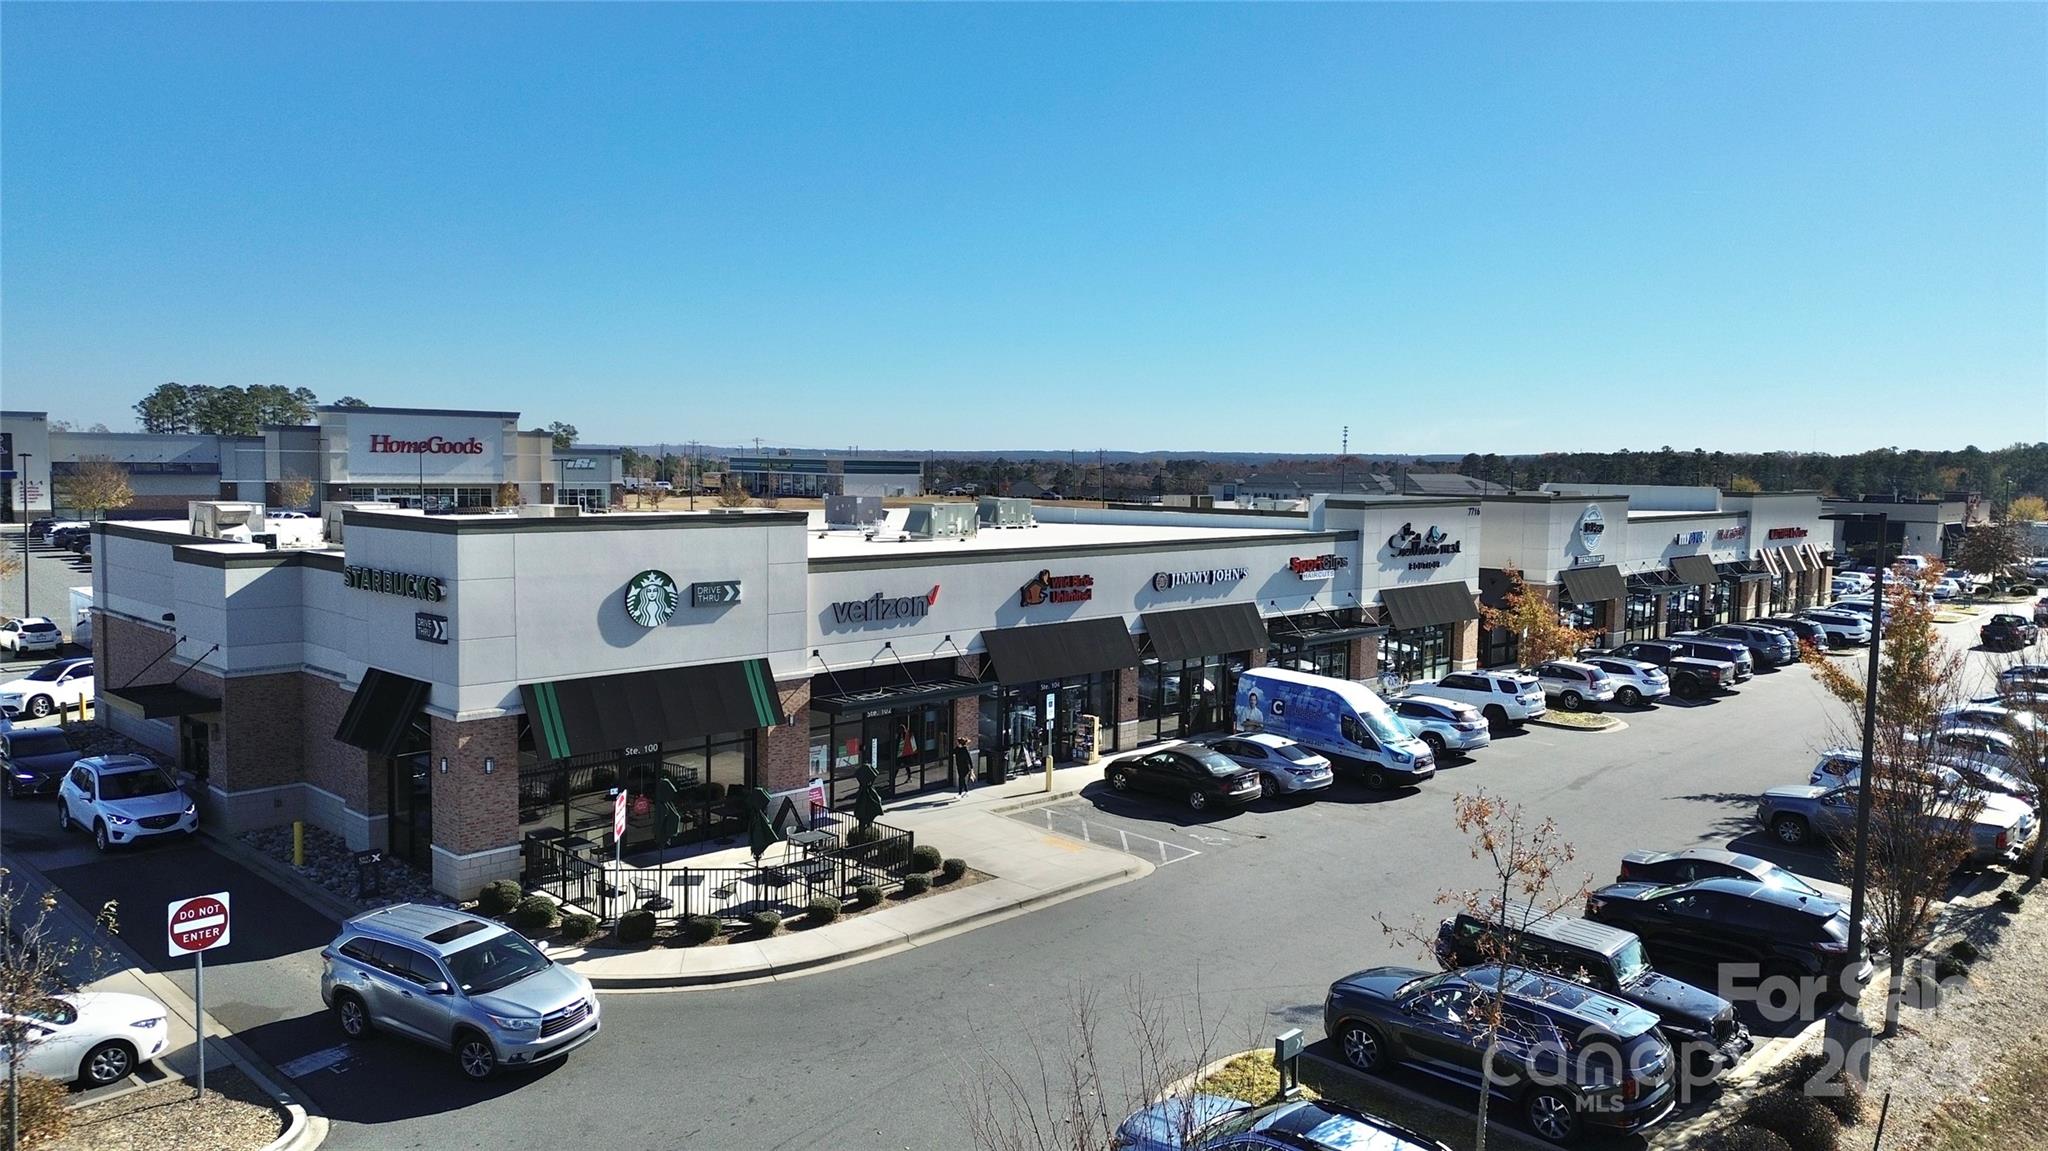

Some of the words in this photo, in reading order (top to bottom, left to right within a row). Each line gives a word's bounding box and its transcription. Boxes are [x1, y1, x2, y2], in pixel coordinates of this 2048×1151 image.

[369, 434, 483, 454] HomeGoods
[1468, 507, 1480, 516] 7716
[344, 565, 441, 602] STARBUCKS
[1171, 570, 1210, 588] JIMMY
[1211, 568, 1249, 585] JOHN'S
[697, 586, 722, 596] DRIVE
[698, 594, 720, 603] THRU
[832, 592, 929, 624] verizon
[1273, 701, 1283, 714] C
[625, 747, 641, 756] Ste.
[644, 744, 659, 753] 100
[180, 909, 195, 920] DO
[199, 904, 220, 917] NOT
[183, 927, 219, 943] ENTER
